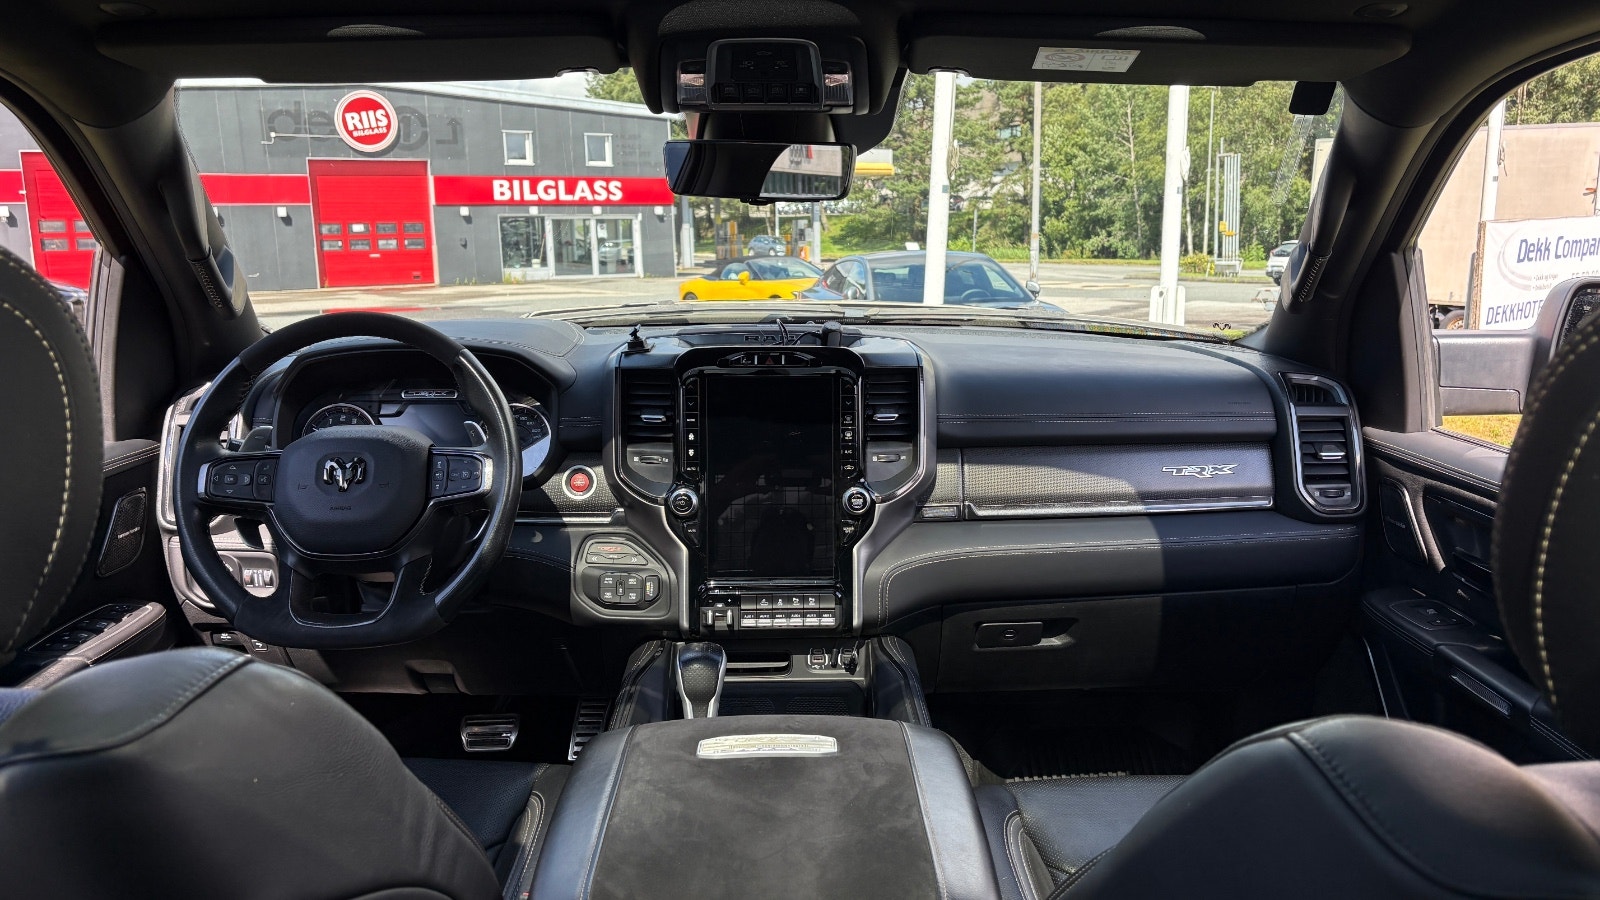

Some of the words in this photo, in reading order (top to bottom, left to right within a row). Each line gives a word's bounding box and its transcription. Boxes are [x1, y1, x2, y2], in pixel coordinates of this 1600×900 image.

[344, 109, 389, 131] RIIS
[352, 127, 388, 138] BILGLASS
[492, 179, 623, 201] BILGLASS
[1516, 237, 1552, 263] Dekk
[1161, 464, 1239, 478] TRX
